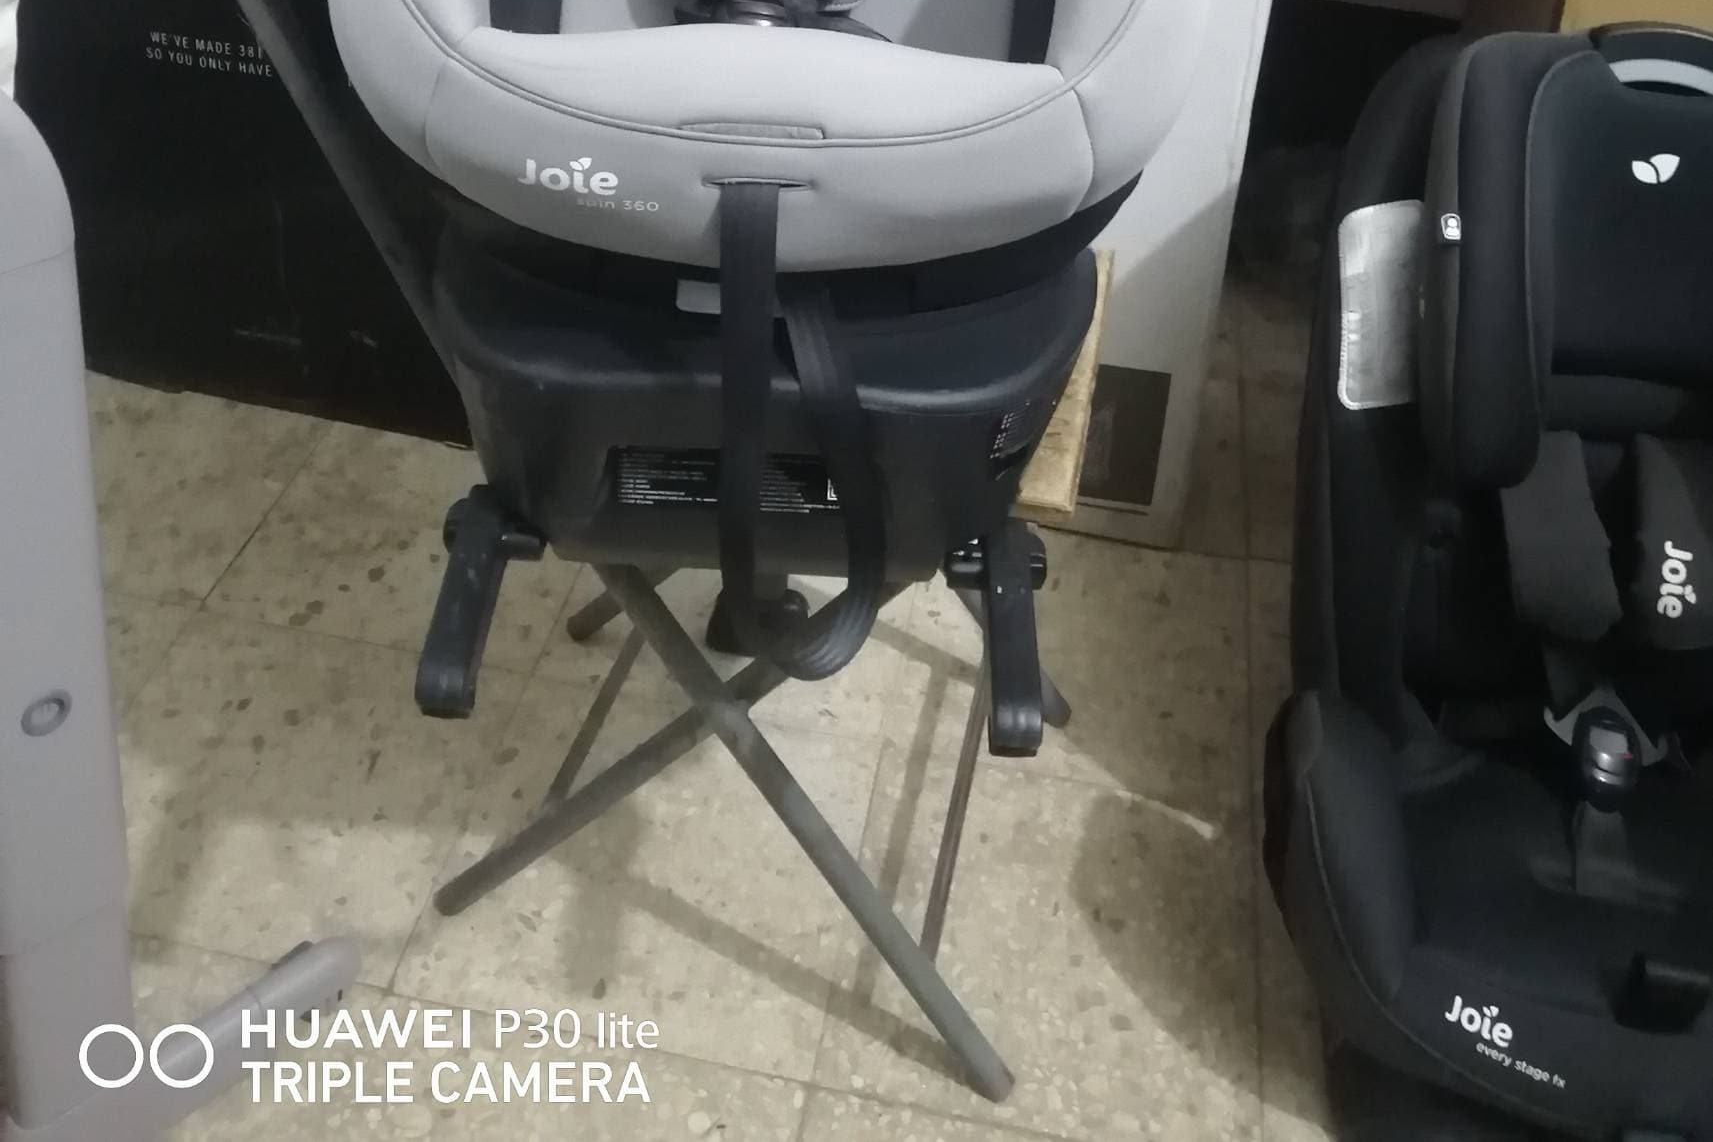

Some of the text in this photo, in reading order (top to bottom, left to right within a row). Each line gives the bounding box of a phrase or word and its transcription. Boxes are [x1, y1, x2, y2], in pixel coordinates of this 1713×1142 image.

[145, 46, 273, 77] SO YOU ONLY HAVE
[149, 31, 190, 49] WE'VE
[195, 38, 232, 56] MADE
[517, 156, 619, 196] Joie
[622, 200, 660, 212] 360
[1656, 540, 1697, 619] Joie
[1445, 995, 1514, 1048] Joie
[1476, 1042, 1512, 1067] every
[1514, 1060, 1550, 1083] stage
